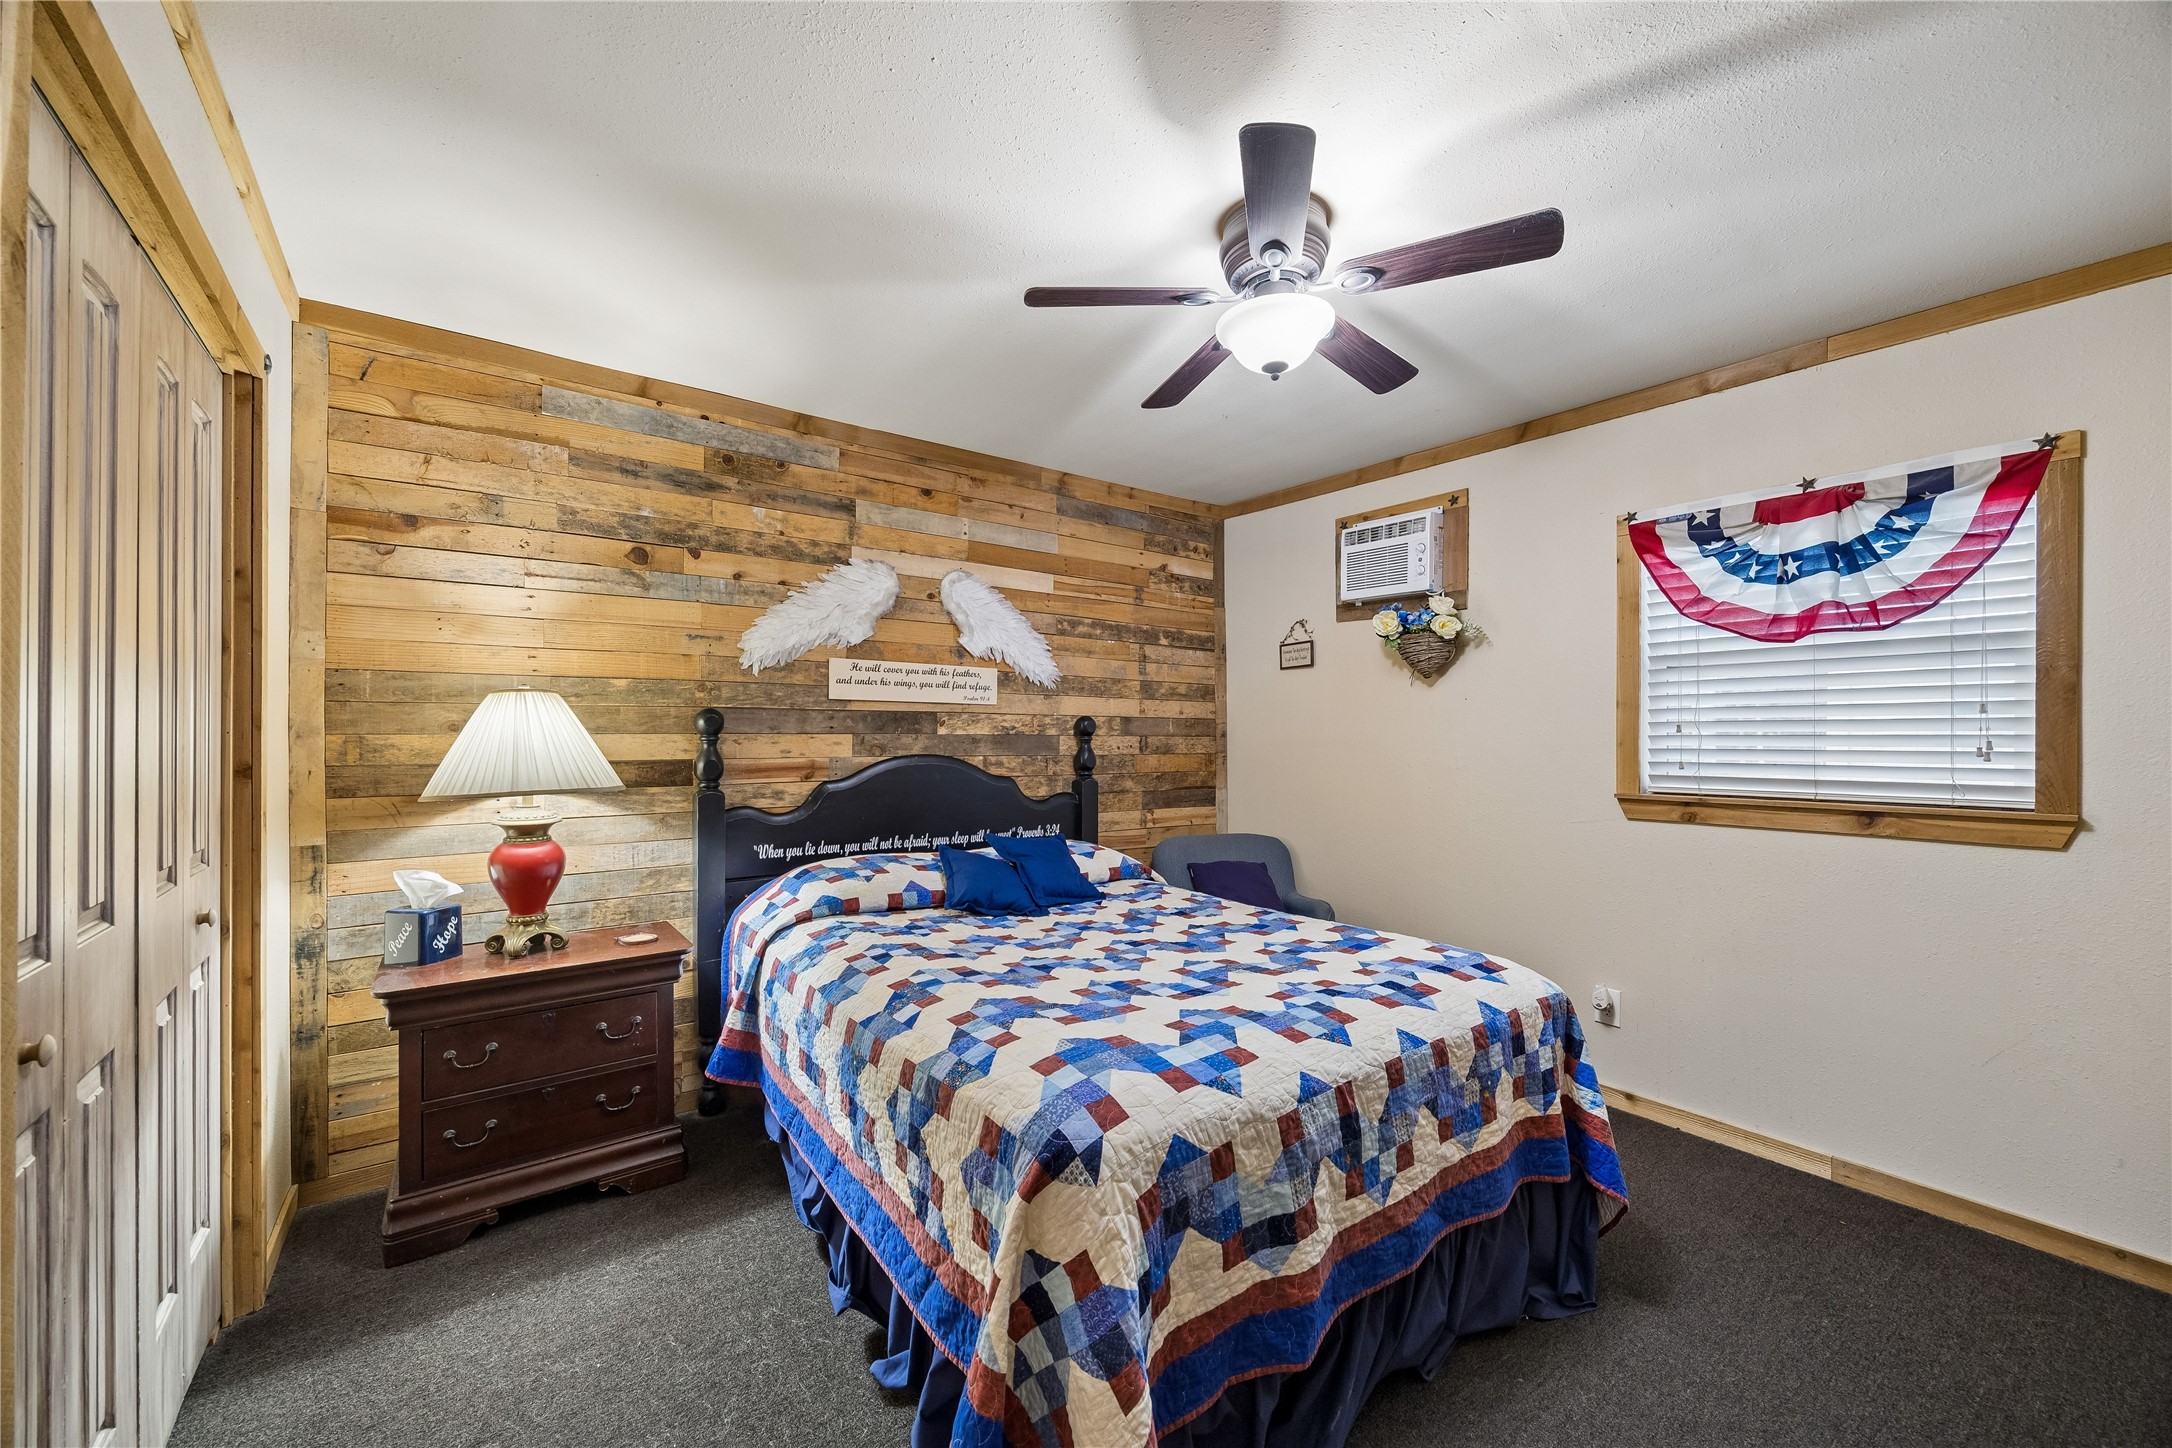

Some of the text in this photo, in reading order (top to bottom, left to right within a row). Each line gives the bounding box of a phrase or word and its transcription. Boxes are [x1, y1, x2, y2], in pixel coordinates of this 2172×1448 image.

[835, 675, 993, 693] and under his wings, you will find refuge.
[849, 662, 982, 679] He will cover you with his feathers,
[786, 846, 803, 862] you
[805, 841, 816, 856] lie
[817, 839, 843, 855] down,
[844, 842, 860, 857] you
[862, 836, 879, 851] will
[880, 837, 893, 850] not
[893, 835, 902, 849] be
[904, 832, 931, 852] afraid;
[932, 836, 950, 850] your
[951, 831, 969, 847] sleep
[971, 829, 984, 843] will
[1016, 824, 1044, 838] Proverbs
[1045, 824, 1061, 836] 3:24
[388, 922, 413, 957] Peace
[432, 916, 458, 954] Hope
